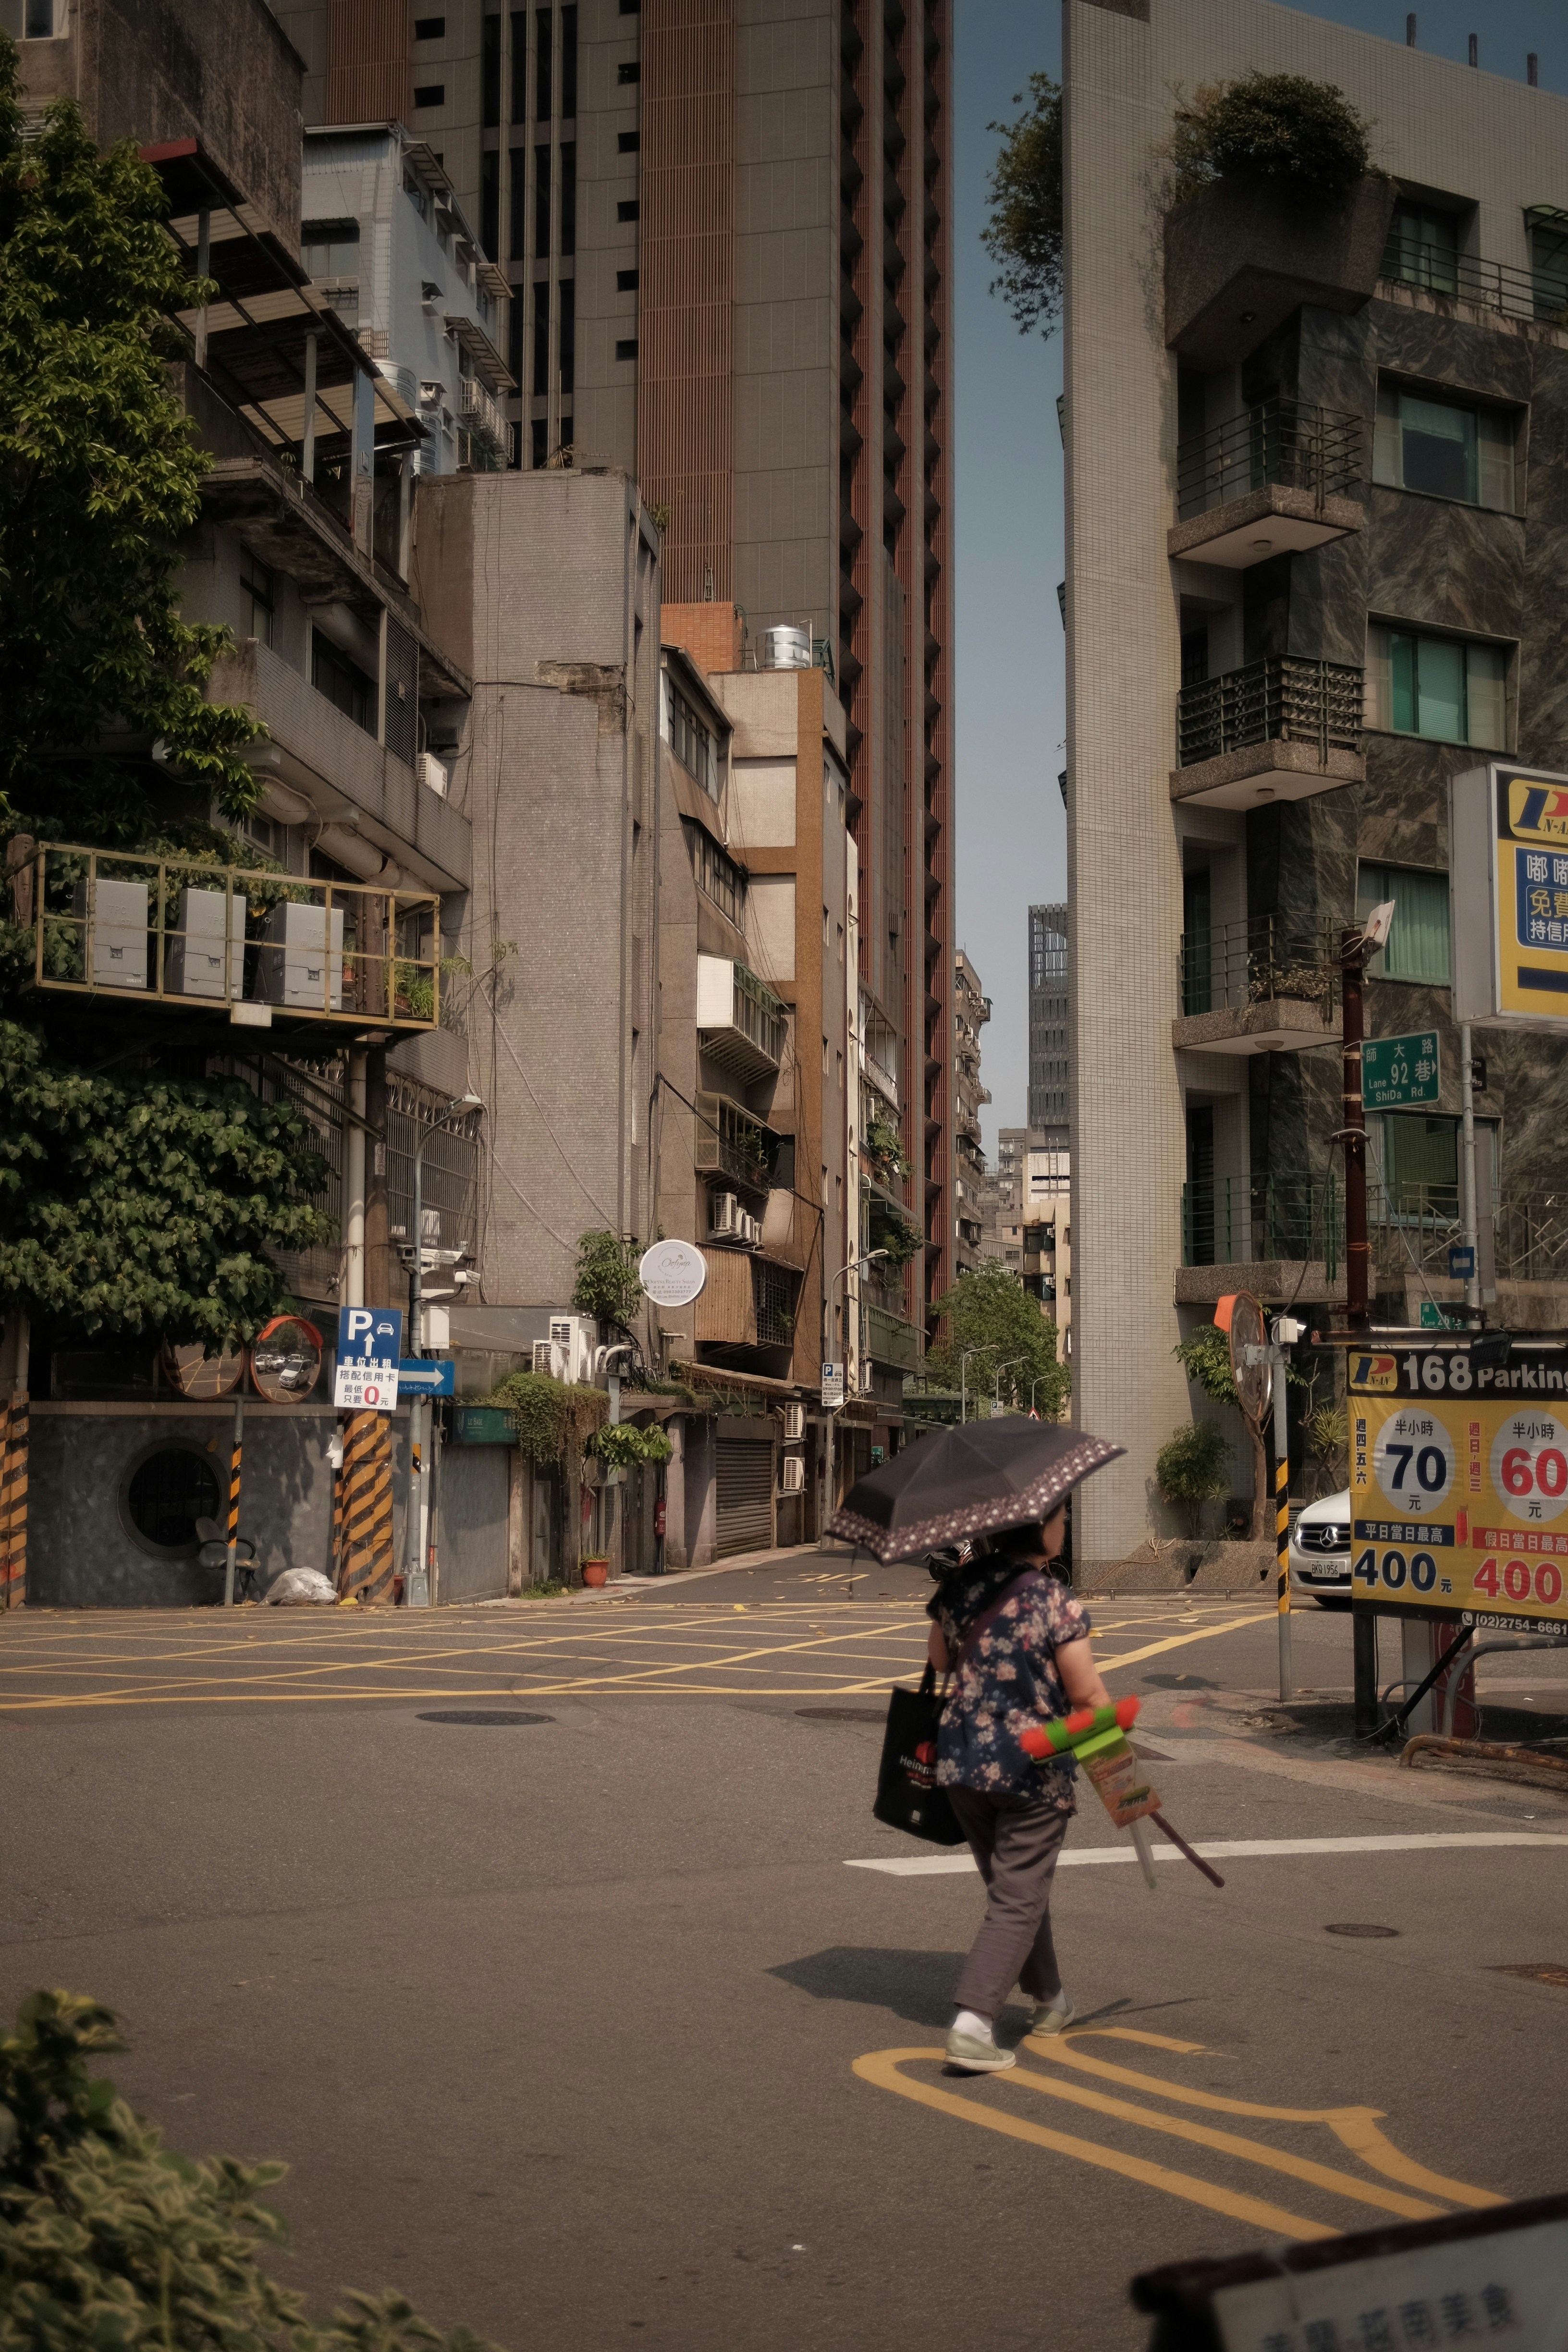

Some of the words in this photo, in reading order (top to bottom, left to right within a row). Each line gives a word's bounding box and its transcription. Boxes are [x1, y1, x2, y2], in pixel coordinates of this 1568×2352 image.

[1543, 819, 1568, 835] N-A
[1366, 1038, 1433, 1063] 師大路
[1369, 1079, 1387, 1089] Lane
[1391, 1062, 1409, 1085] 92
[1415, 1059, 1431, 1081] 巷
[1376, 1090, 1402, 1102] ShiDa
[1411, 1086, 1426, 1097] Rd.
[348, 1310, 373, 1340] P
[343, 1356, 392, 1369] 車位出租
[825, 1366, 832, 1375] P
[340, 1370, 395, 1383] 搭配信用卡
[1403, 1355, 1472, 1390] 168
[1478, 1364, 1568, 1393] Parkin
[344, 1384, 363, 1394] 最低
[343, 1395, 362, 1404] 只要
[380, 1397, 389, 1406] 元
[1394, 1420, 1433, 1436] 半小時
[1512, 1421, 1555, 1440] 半小時
[1385, 1443, 1446, 1492] 70
[1501, 1447, 1568, 1497] 60
[1409, 1494, 1421, 1510] 元
[1528, 1502, 1542, 1518] 元
[1365, 1523, 1443, 1544] 平日當日最高
[1484, 1531, 1568, 1553] 假日當日最高
[1354, 1548, 1437, 1591] 400
[1440, 1579, 1452, 1593] 元
[1474, 1558, 1562, 1604] 400
[1476, 1614, 1568, 1635] (02)2754-6661
